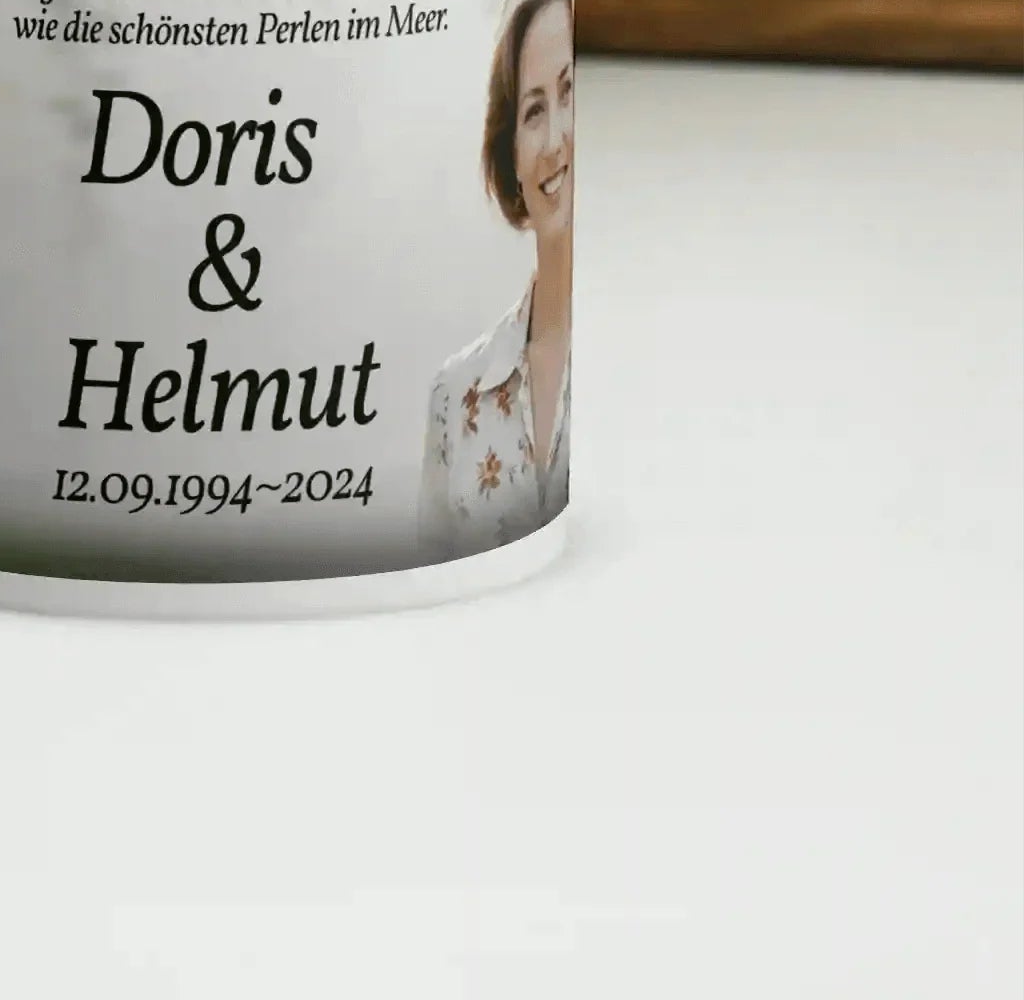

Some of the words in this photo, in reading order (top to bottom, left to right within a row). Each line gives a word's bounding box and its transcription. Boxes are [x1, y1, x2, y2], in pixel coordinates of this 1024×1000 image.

[12, 7, 60, 41] wie
[62, 8, 104, 44] die
[107, 11, 249, 47] schönsten
[255, 9, 341, 46] Perlen
[346, 7, 381, 41] im
[384, 2, 449, 38] Meer.
[80, 87, 319, 188] Doris
[187, 212, 263, 313] &
[57, 337, 382, 434] Helmut
